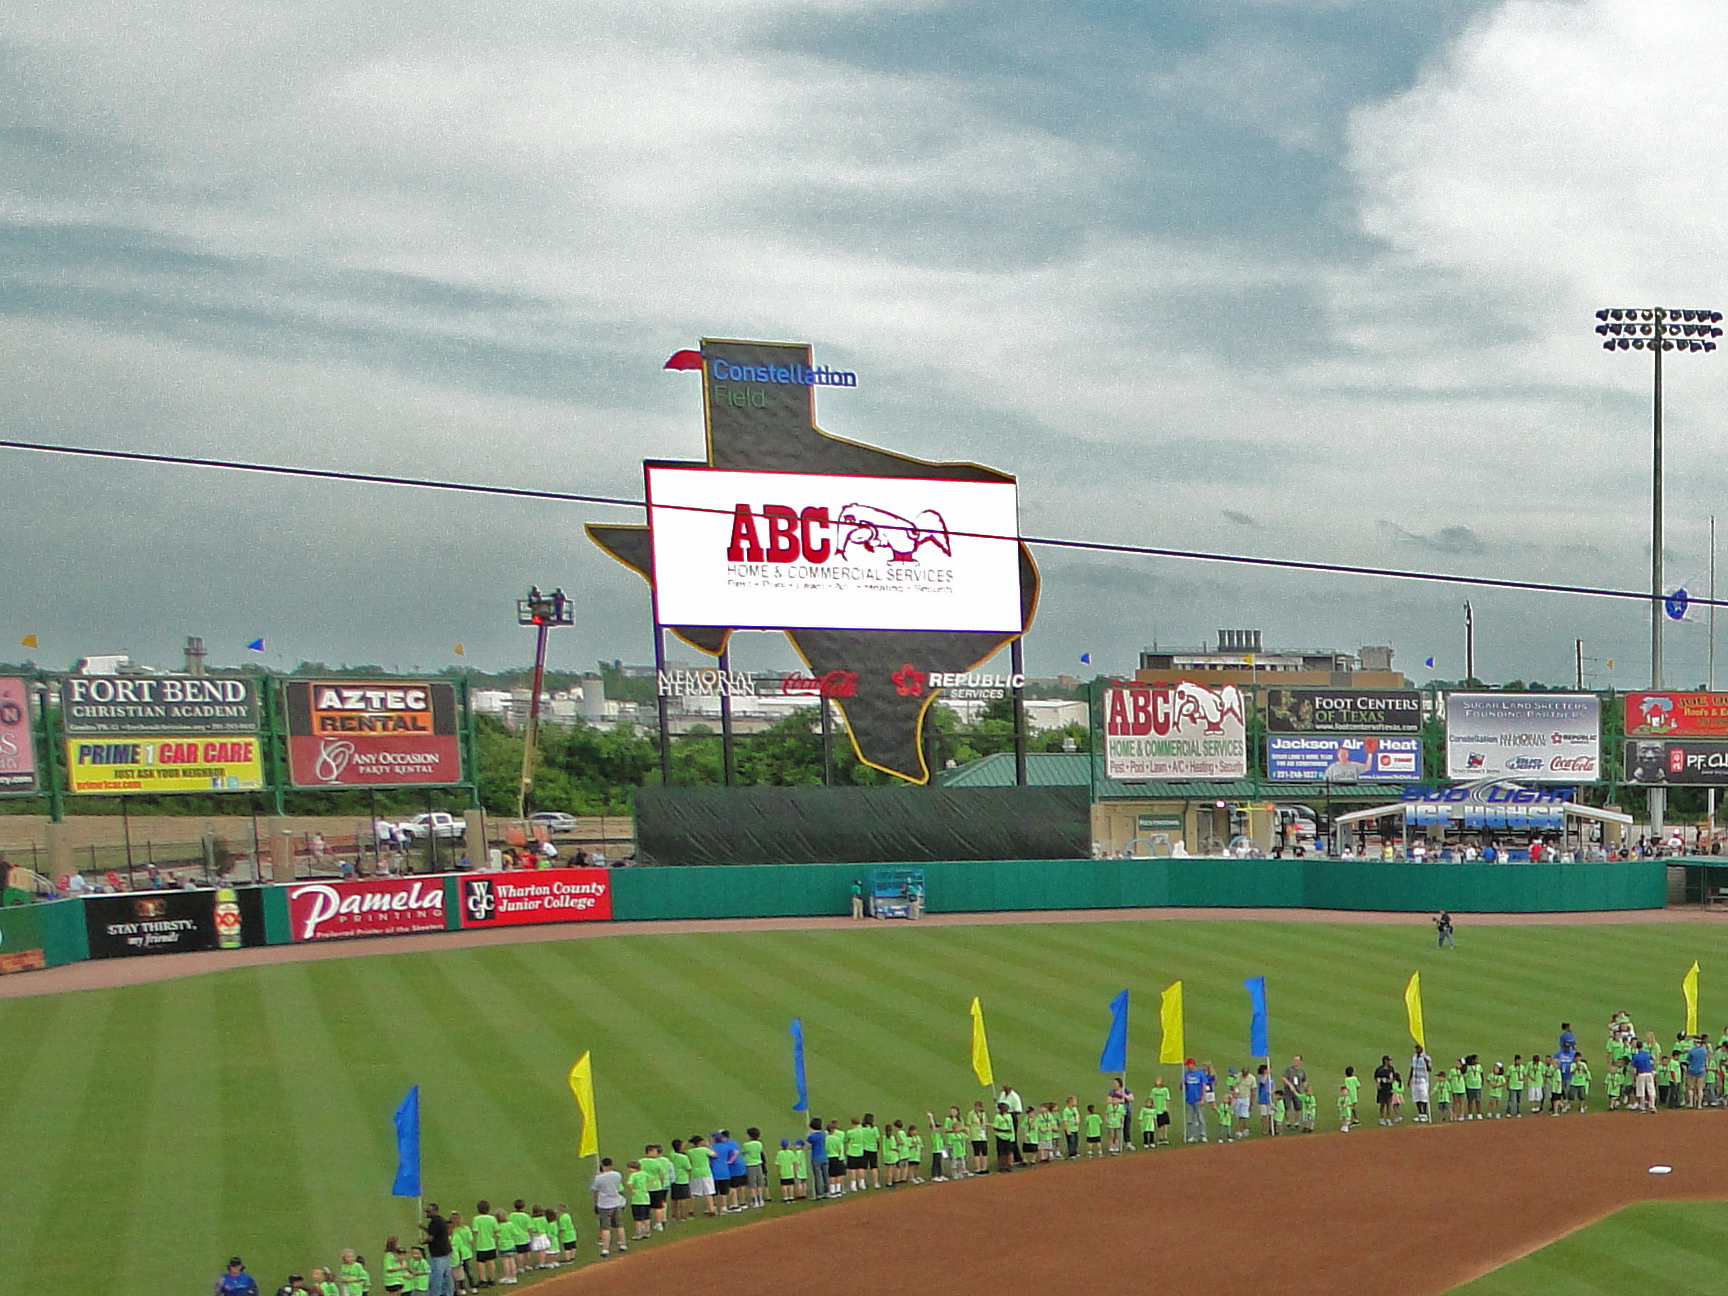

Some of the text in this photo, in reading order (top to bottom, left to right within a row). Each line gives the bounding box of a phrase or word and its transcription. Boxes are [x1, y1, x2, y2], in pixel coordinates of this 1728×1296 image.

[712, 359, 857, 387] Constellation
[714, 387, 766, 407] Field
[727, 503, 830, 563] ABC
[728, 565, 954, 582] HOME & COMMERCIAL SERVICES
[658, 669, 754, 684] MEMORIAL
[928, 672, 1025, 689] REPUBLIC
[70, 680, 246, 702] FORT BEND
[658, 682, 755, 696] HERMANN
[950, 689, 1004, 699] SERVICES
[318, 689, 427, 710] AZTEC
[1314, 697, 1418, 710] FOOT CENTERS
[1534, 702, 1588, 710] SKEETERS
[74, 705, 249, 718] CHRISTIAN ACADEMY
[1108, 689, 1174, 736] ABC
[1315, 710, 1385, 722] OF TEXAS
[1465, 709, 1586, 718] FOUNDING PARTNERS
[320, 716, 427, 731] RENTAL
[1271, 738, 1418, 750] Jackson Air Heat
[1449, 734, 1498, 743] Constellation
[78, 742, 253, 765] PRIME 1 CAR CARE
[1109, 740, 1244, 757] HOME & COMMERCIAL SERVICES
[352, 752, 440, 765] ANY OCCASION
[114, 769, 136, 779] JUST
[137, 769, 155, 779] ASK
[157, 768, 180, 778] YOUR
[359, 765, 434, 775] PARTY RENTAL
[1110, 761, 1124, 773] Pest
[1401, 785, 1578, 803] BUD LIGHT
[1406, 805, 1564, 826] ICE HOUSE
[497, 881, 606, 898] Wharton County
[292, 881, 444, 940] Pamela
[498, 896, 596, 912] Junior College
[339, 910, 443, 924] PRINTING
[107, 923, 139, 936] STAY
[127, 932, 180, 948] my friends
